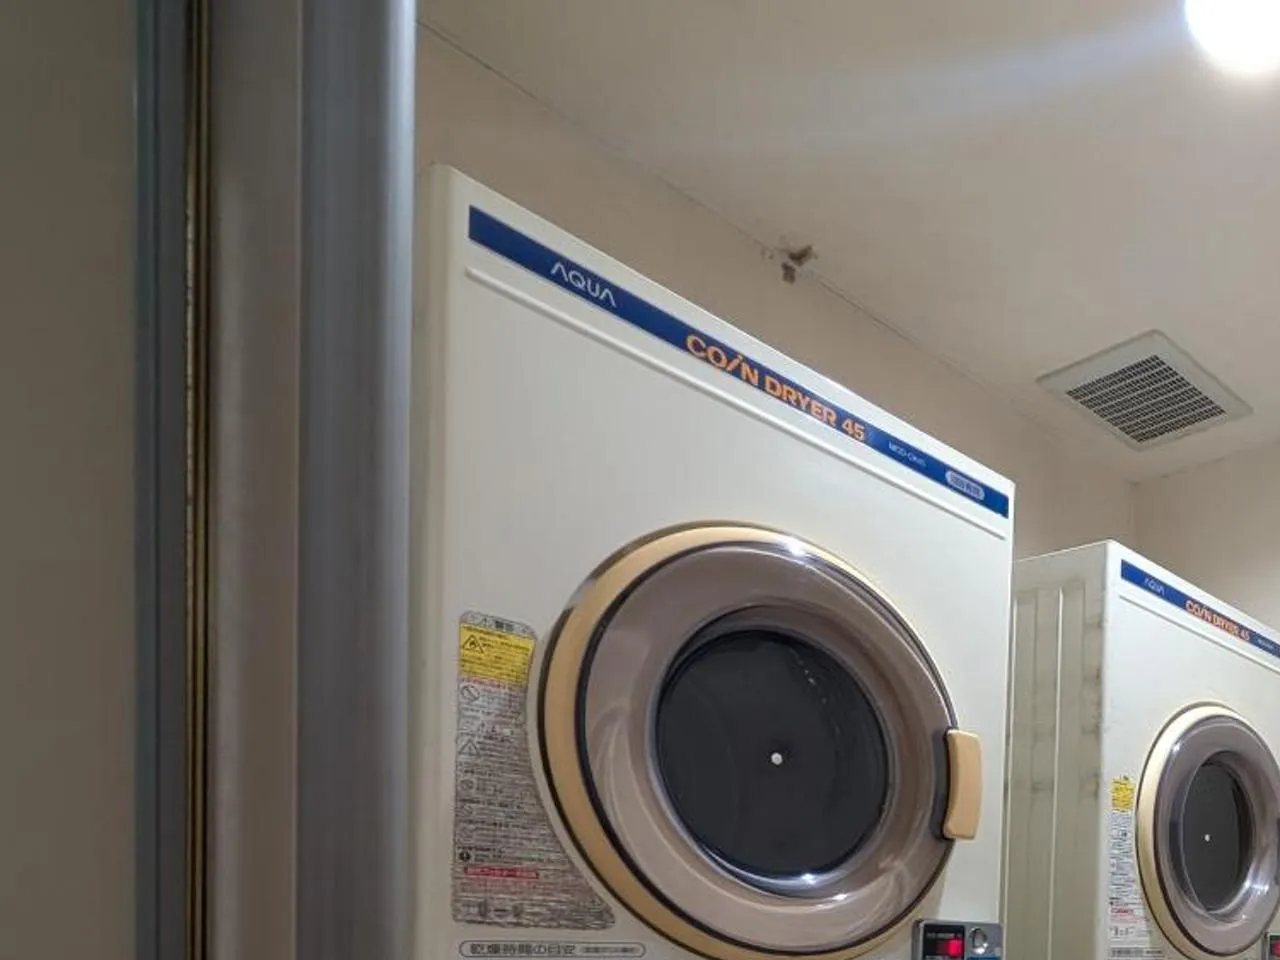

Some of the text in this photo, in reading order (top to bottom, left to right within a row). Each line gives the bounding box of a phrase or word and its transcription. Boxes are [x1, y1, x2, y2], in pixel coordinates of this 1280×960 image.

[551, 261, 866, 442] AQUA COIN DRYER 45
[1212, 613, 1240, 637] DRYER
[1239, 627, 1251, 642] 45
